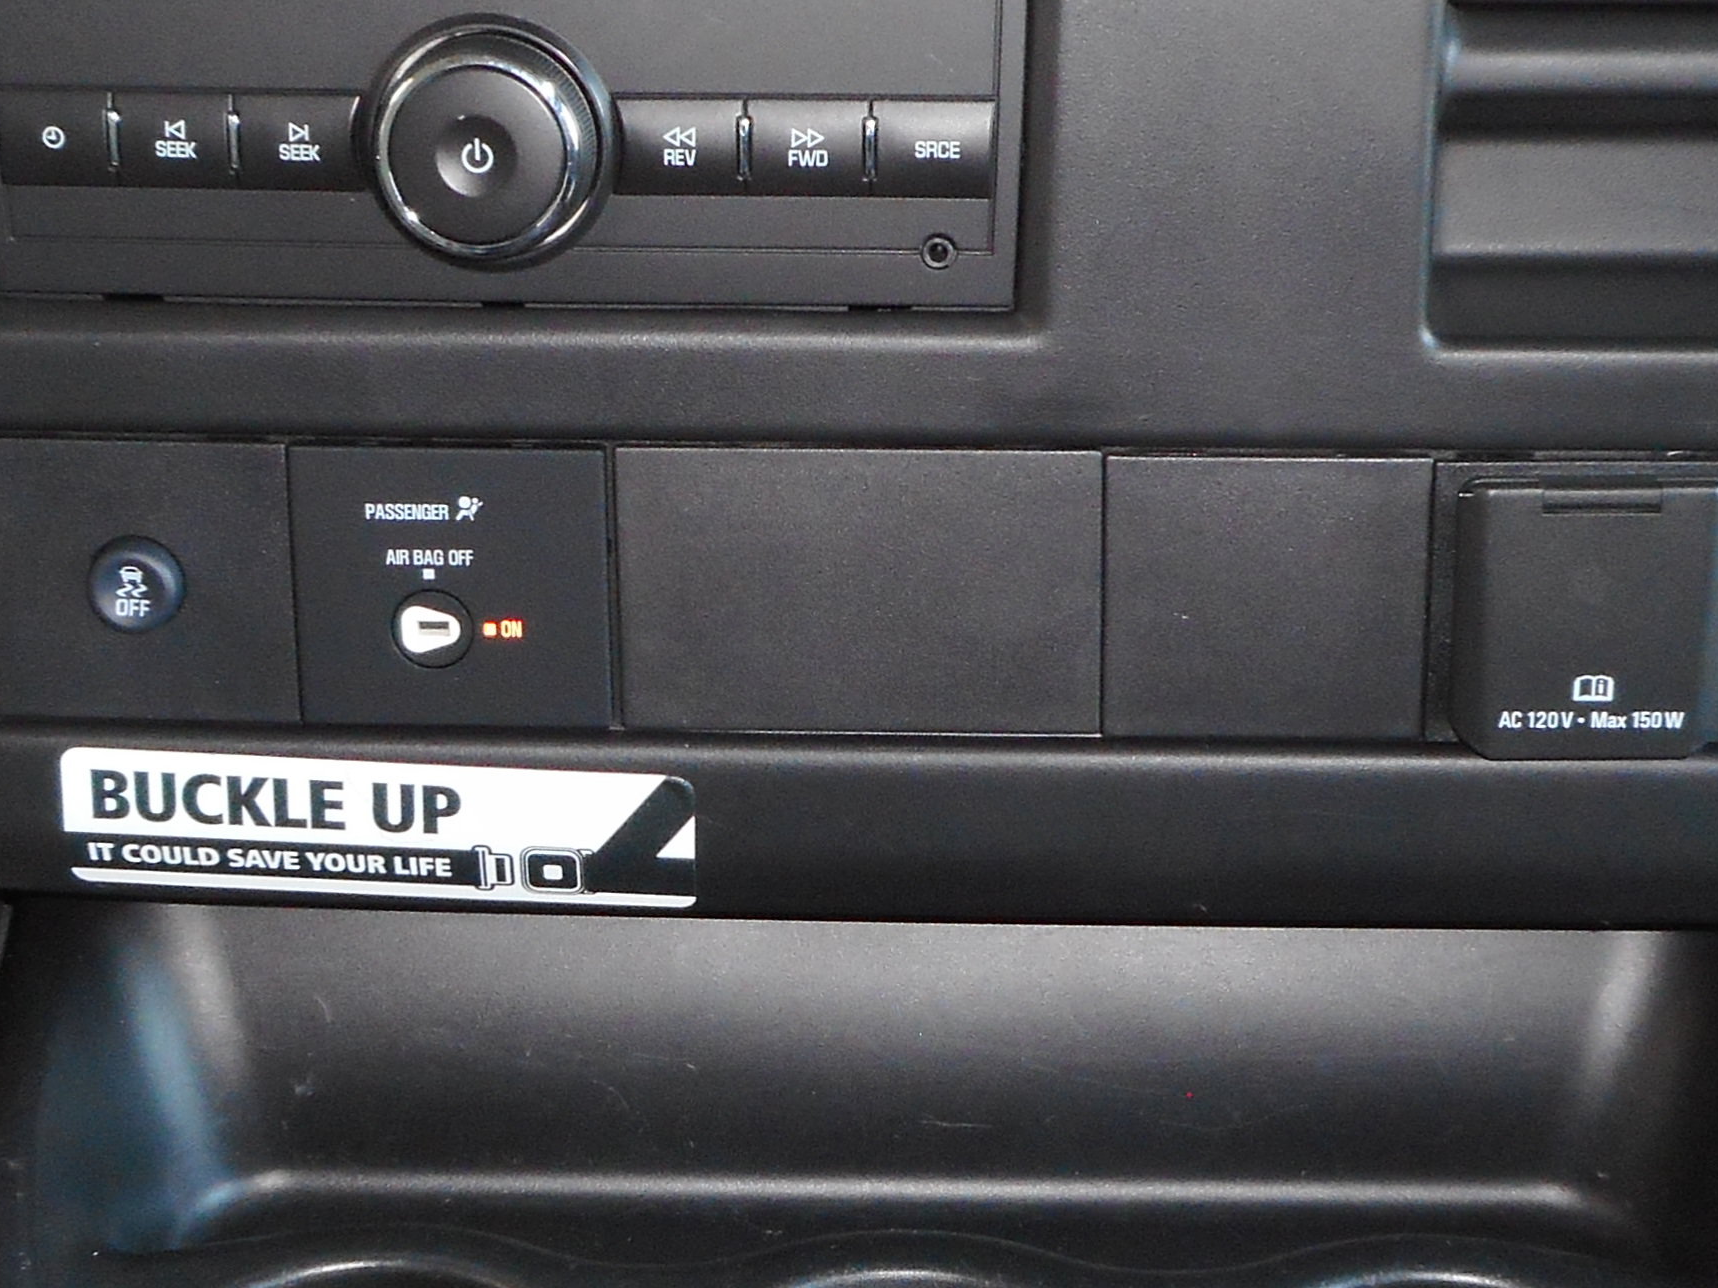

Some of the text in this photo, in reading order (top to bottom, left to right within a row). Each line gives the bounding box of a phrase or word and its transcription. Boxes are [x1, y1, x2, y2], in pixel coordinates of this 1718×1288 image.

[154, 140, 197, 159] SEEK
[278, 143, 321, 161] SEEK
[663, 148, 697, 166] REV
[787, 149, 829, 167] FWD
[914, 139, 962, 159] SRCE
[364, 503, 450, 521] PASSENGER
[385, 548, 474, 567] AIR BAG OFF
[113, 598, 151, 618] OFF
[500, 620, 524, 640] ON
[1498, 711, 1523, 729] AC
[1590, 711, 1628, 729] Max
[90, 769, 461, 835] BUCKLE UP
[87, 841, 453, 878] IT COULD SAVE YOUR LIFE
